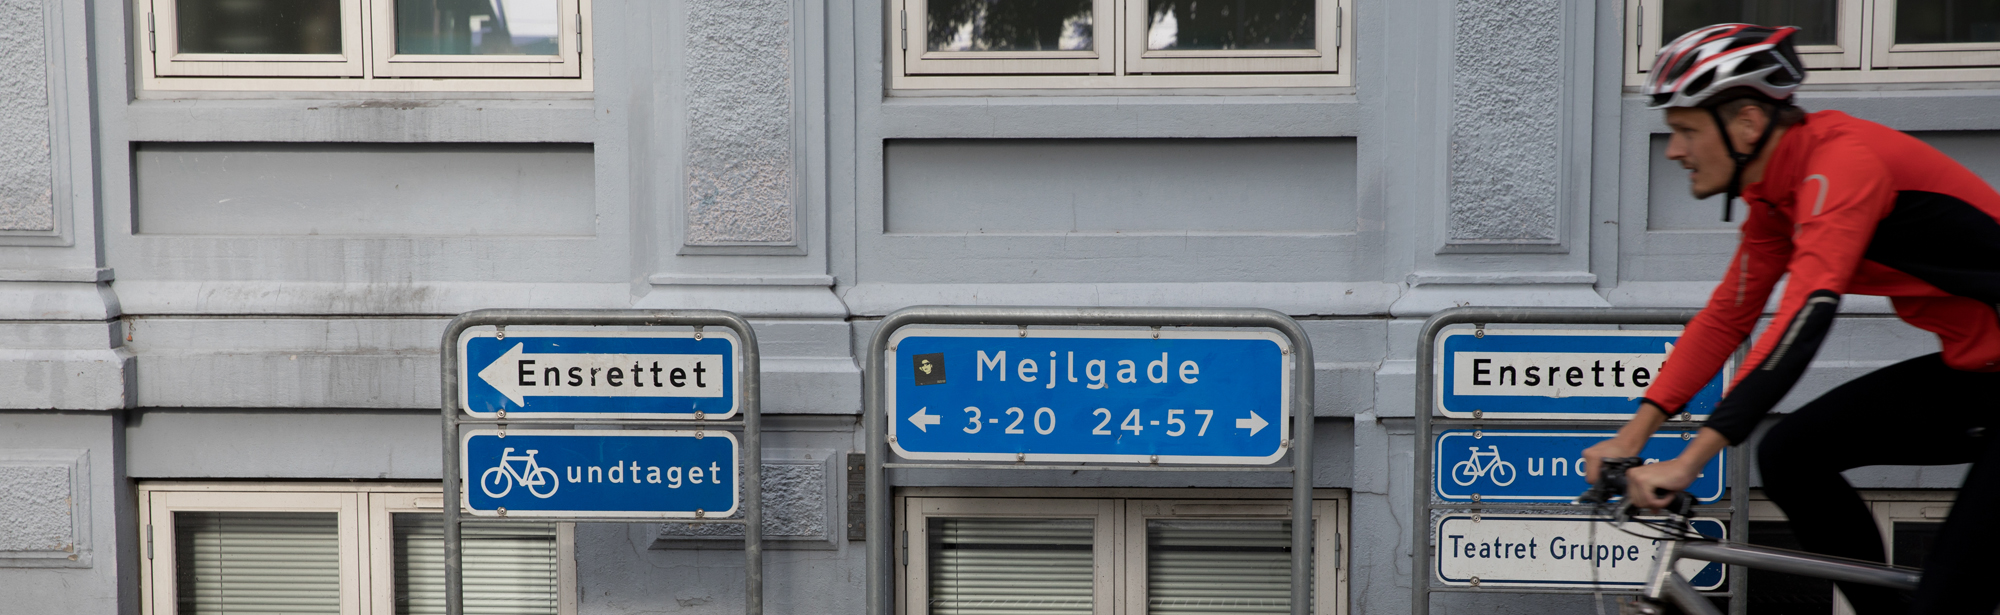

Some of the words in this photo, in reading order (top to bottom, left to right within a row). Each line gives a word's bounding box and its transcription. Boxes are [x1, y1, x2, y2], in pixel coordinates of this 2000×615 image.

[518, 359, 707, 388] Ensrettet
[976, 349, 1200, 390] Mejlgade
[1472, 358, 1667, 388] Ensrette
[962, 406, 1057, 436] 3-20
[1092, 408, 1215, 437] 24-57
[567, 460, 721, 489] undtaget
[1448, 534, 1537, 560] Teatret
[1550, 536, 1640, 568] Gruppe
